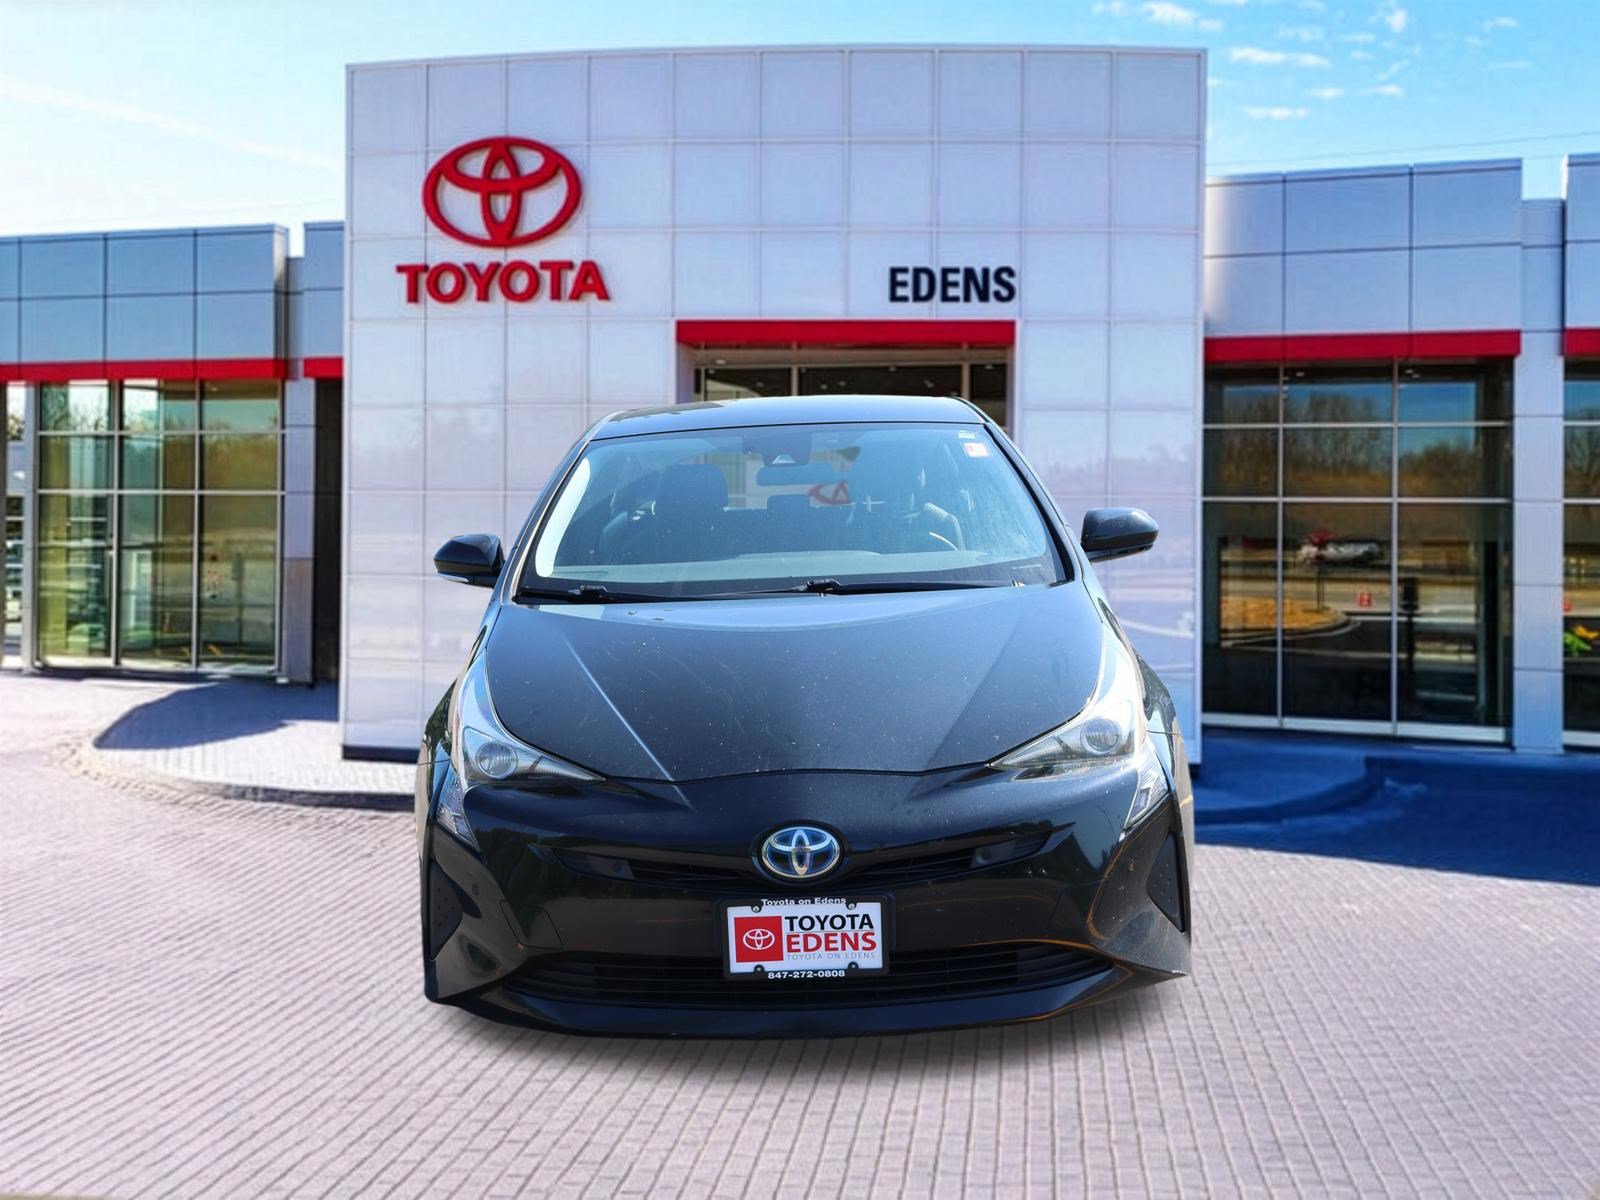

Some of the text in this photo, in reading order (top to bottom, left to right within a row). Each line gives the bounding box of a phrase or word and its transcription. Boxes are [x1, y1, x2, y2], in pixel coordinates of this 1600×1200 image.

[396, 260, 610, 303] TOYOTA
[889, 266, 1016, 303] EDENS
[785, 913, 874, 931] TOYOTA
[786, 932, 877, 953] EDENS
[787, 952, 876, 961] TOYOTA ON EDENS
[768, 970, 845, 979] 847-272-0808
